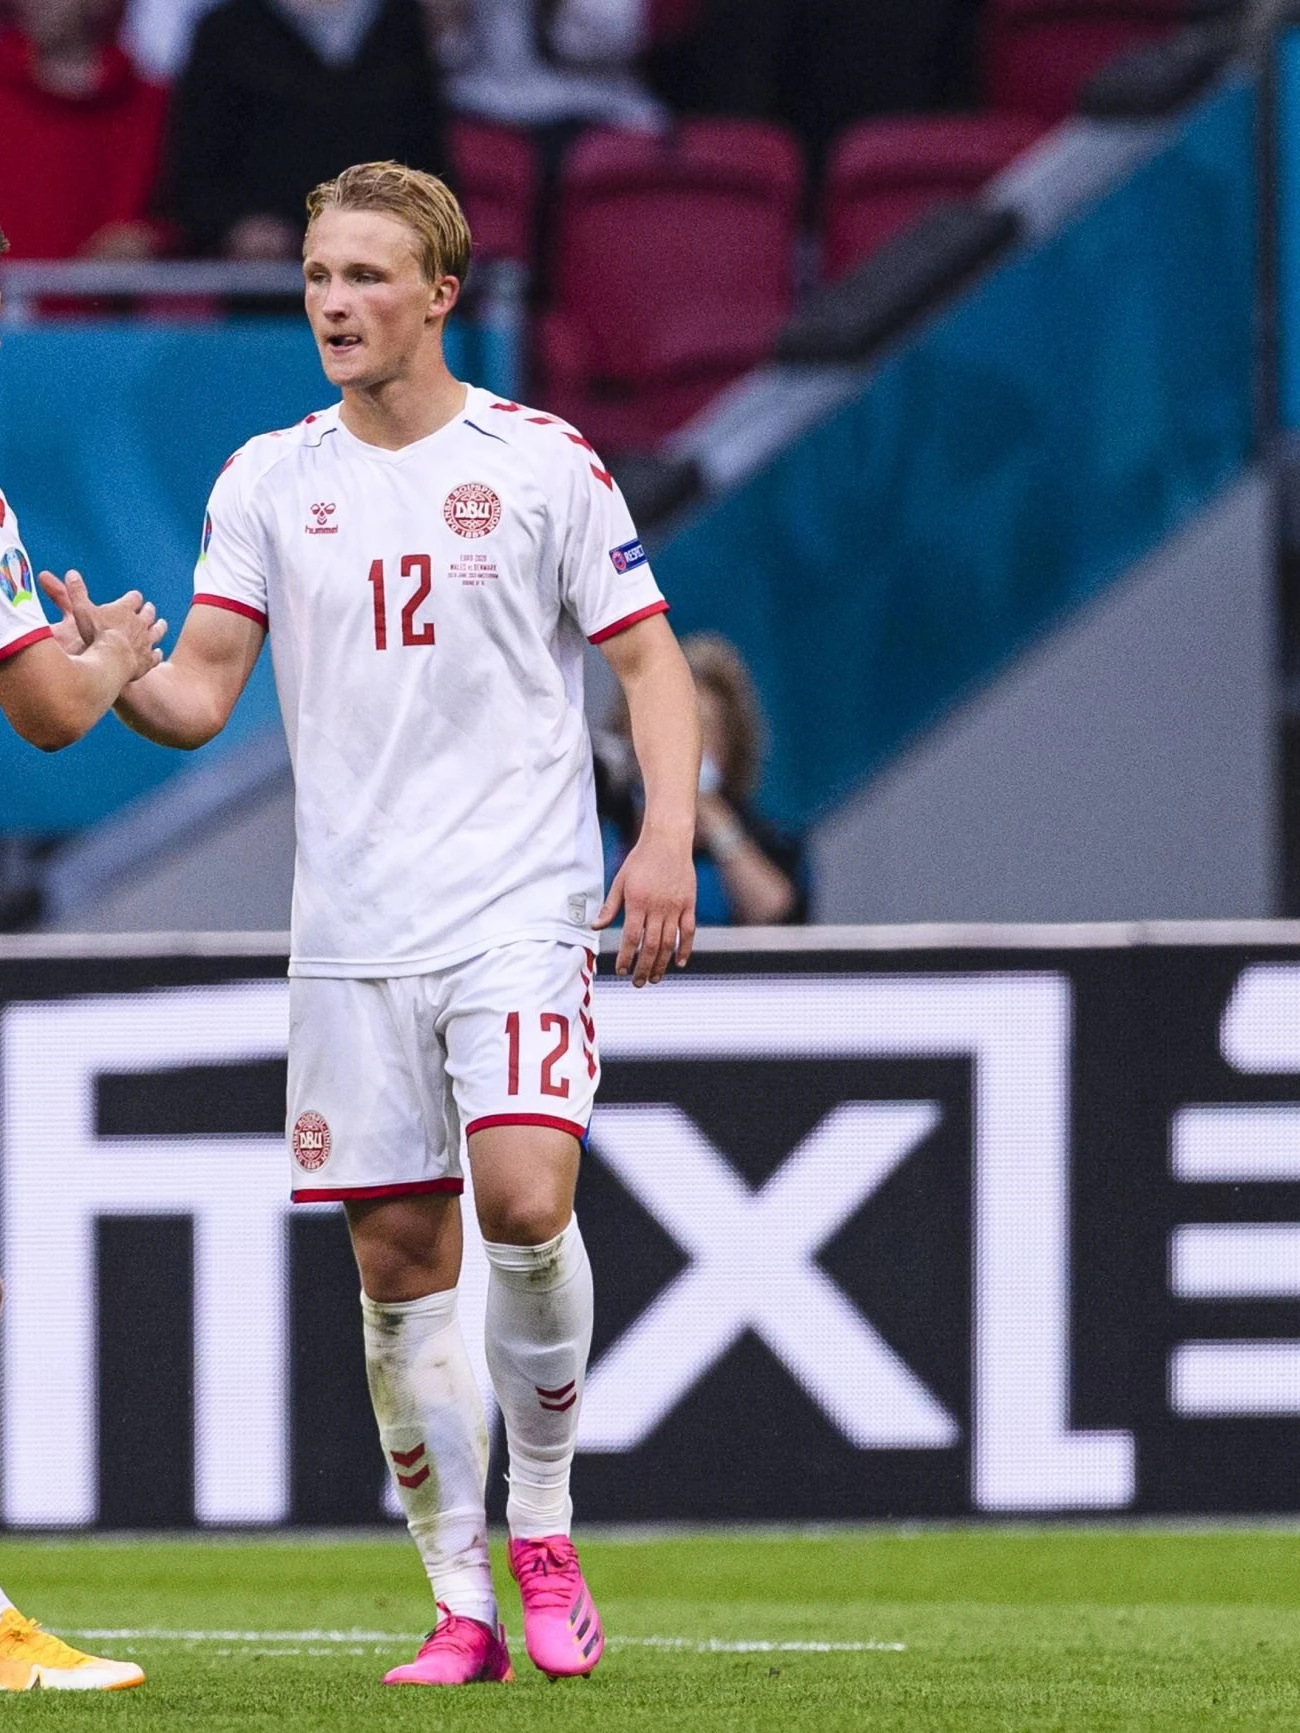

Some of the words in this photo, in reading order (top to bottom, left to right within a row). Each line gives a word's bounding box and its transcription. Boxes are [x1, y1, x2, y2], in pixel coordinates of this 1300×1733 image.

[454, 501, 492, 519] DBU
[368, 554, 435, 651] 12
[505, 1011, 570, 1099] 12
[299, 1131, 323, 1149] DBU
